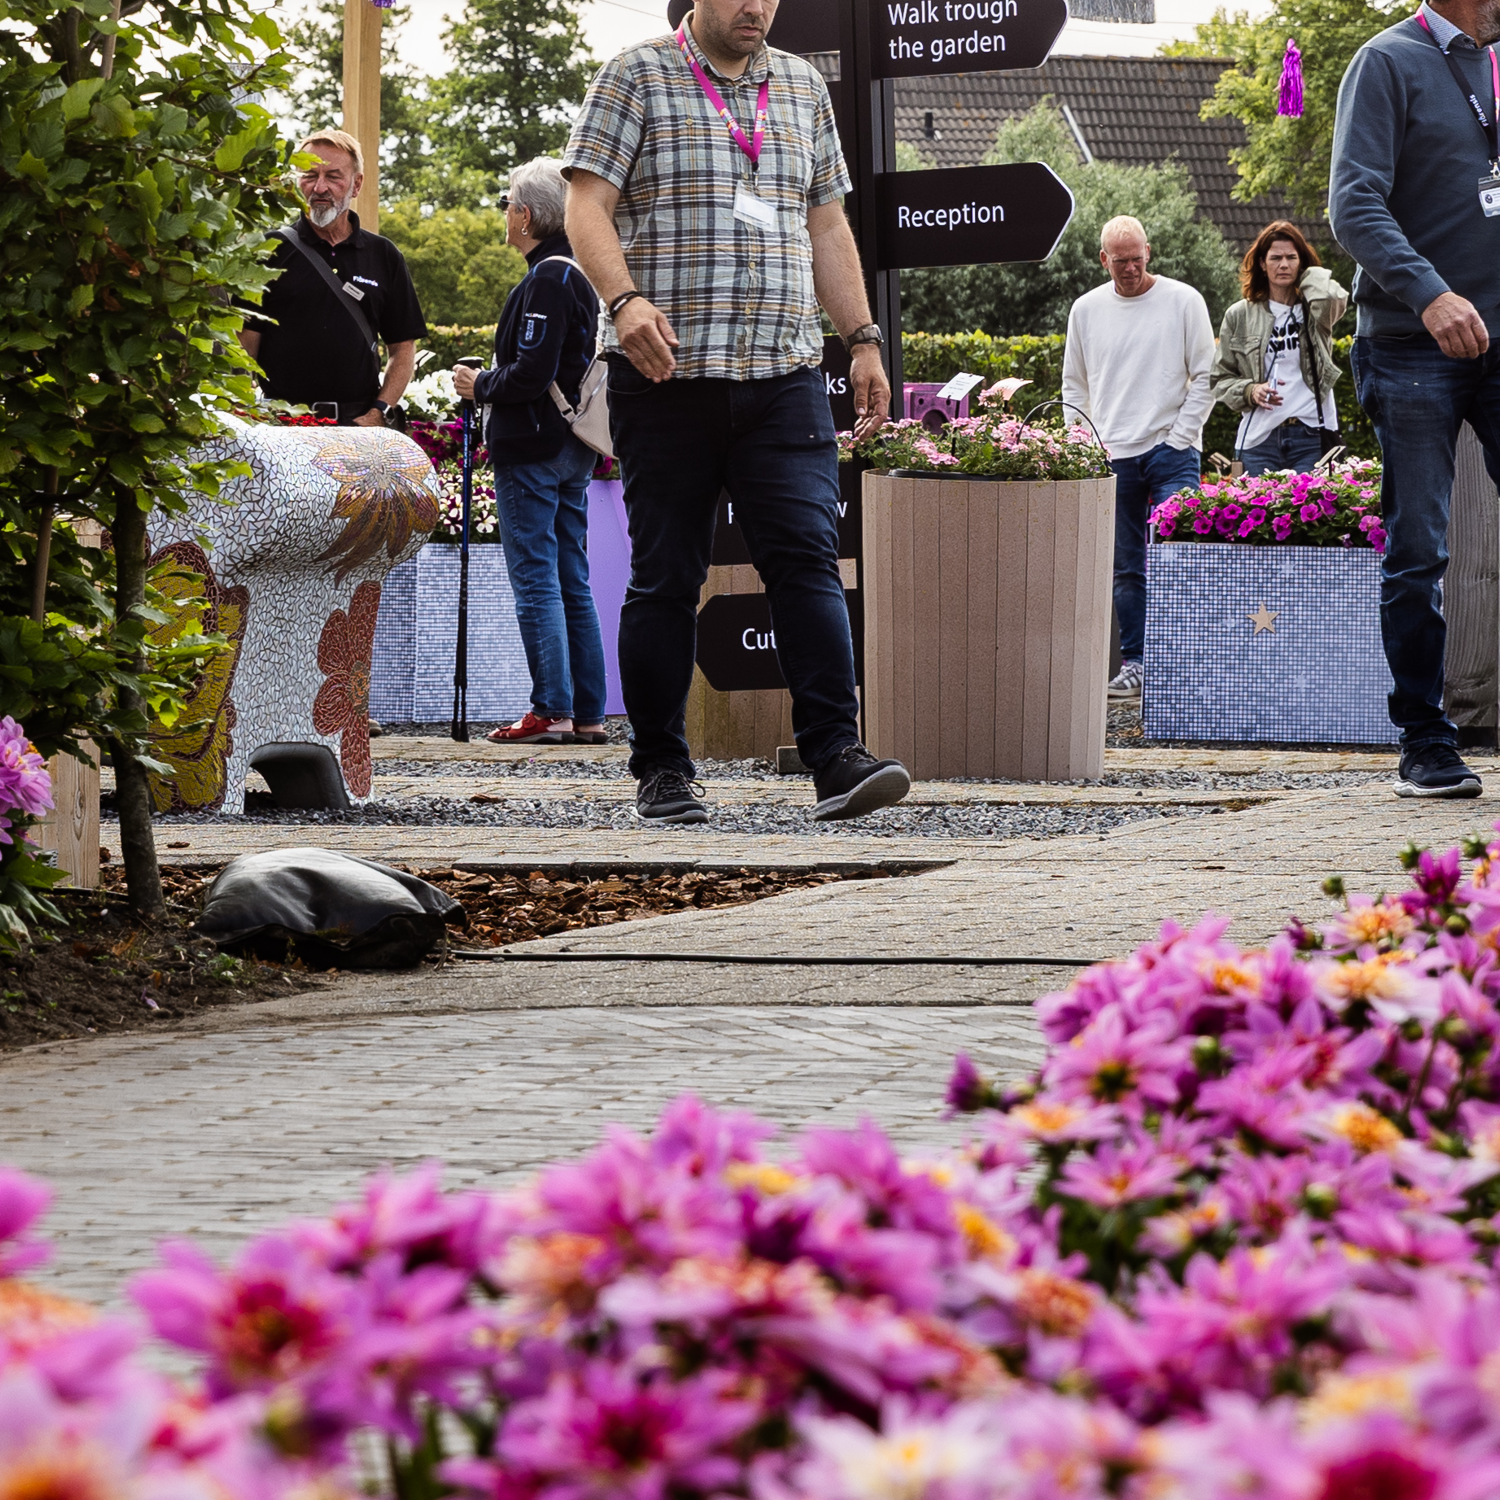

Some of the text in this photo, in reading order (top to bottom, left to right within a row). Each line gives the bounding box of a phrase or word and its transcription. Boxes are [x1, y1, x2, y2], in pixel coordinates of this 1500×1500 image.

[888, 0, 940, 26] Walk
[889, 31, 1006, 62] the garden
[1469, 94, 1489, 127] Florensis
[898, 202, 1005, 231] Reception
